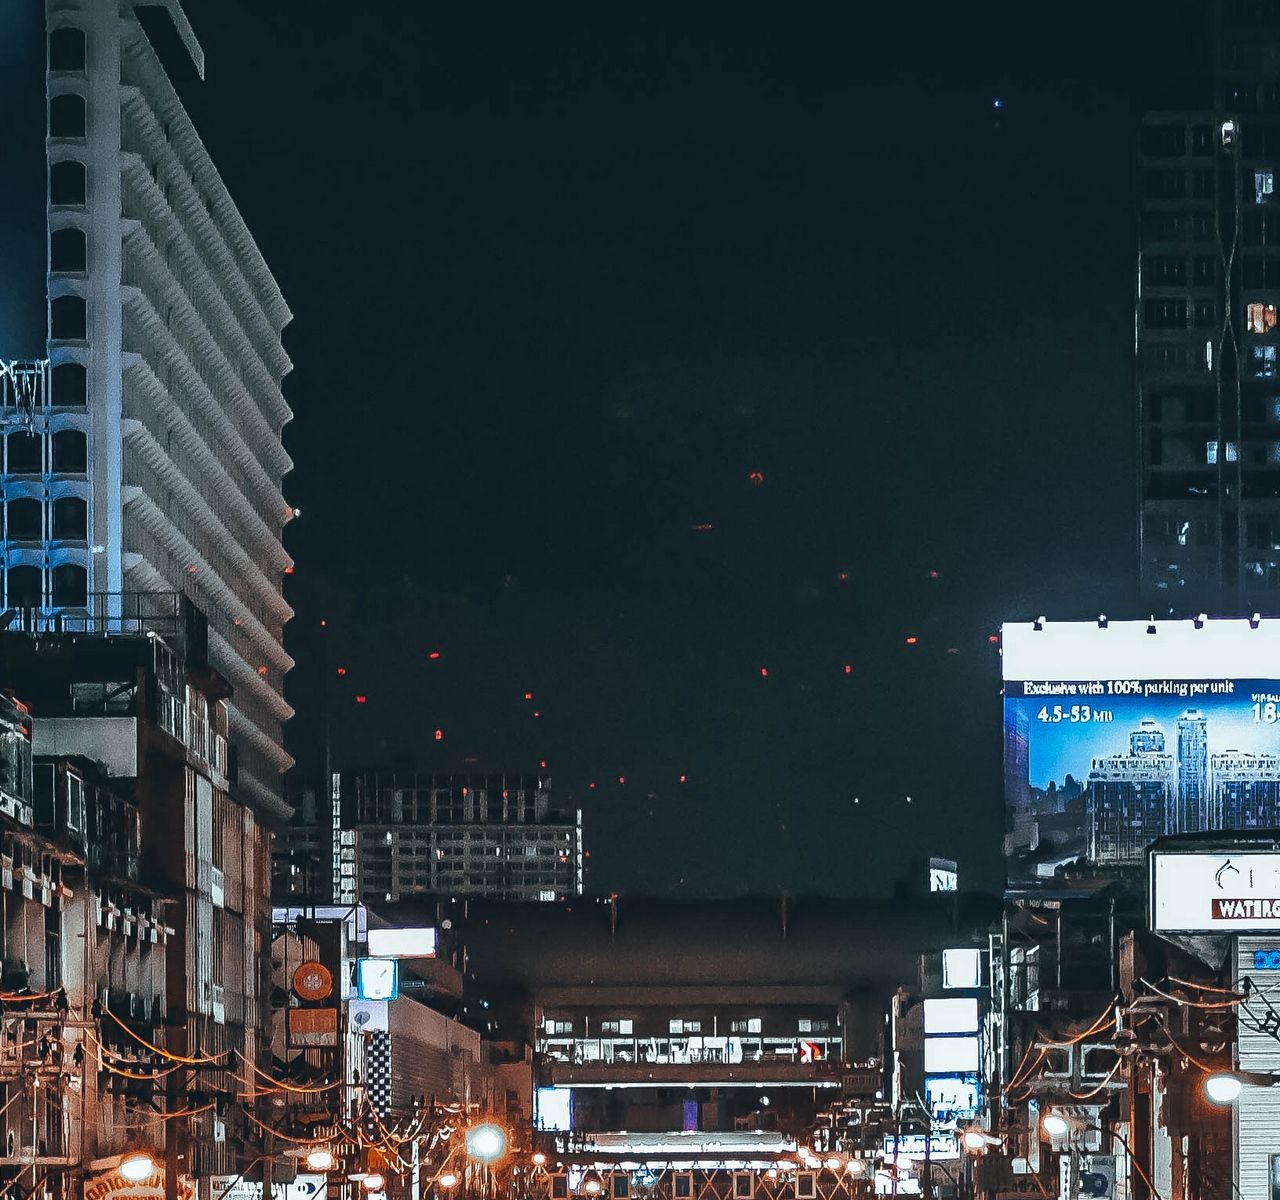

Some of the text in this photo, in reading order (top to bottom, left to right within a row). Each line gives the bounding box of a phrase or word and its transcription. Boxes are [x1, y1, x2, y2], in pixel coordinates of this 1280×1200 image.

[1023, 680, 1235, 697] Exclusive with 100% parking per unit
[1037, 705, 1092, 724] 4.5-53
